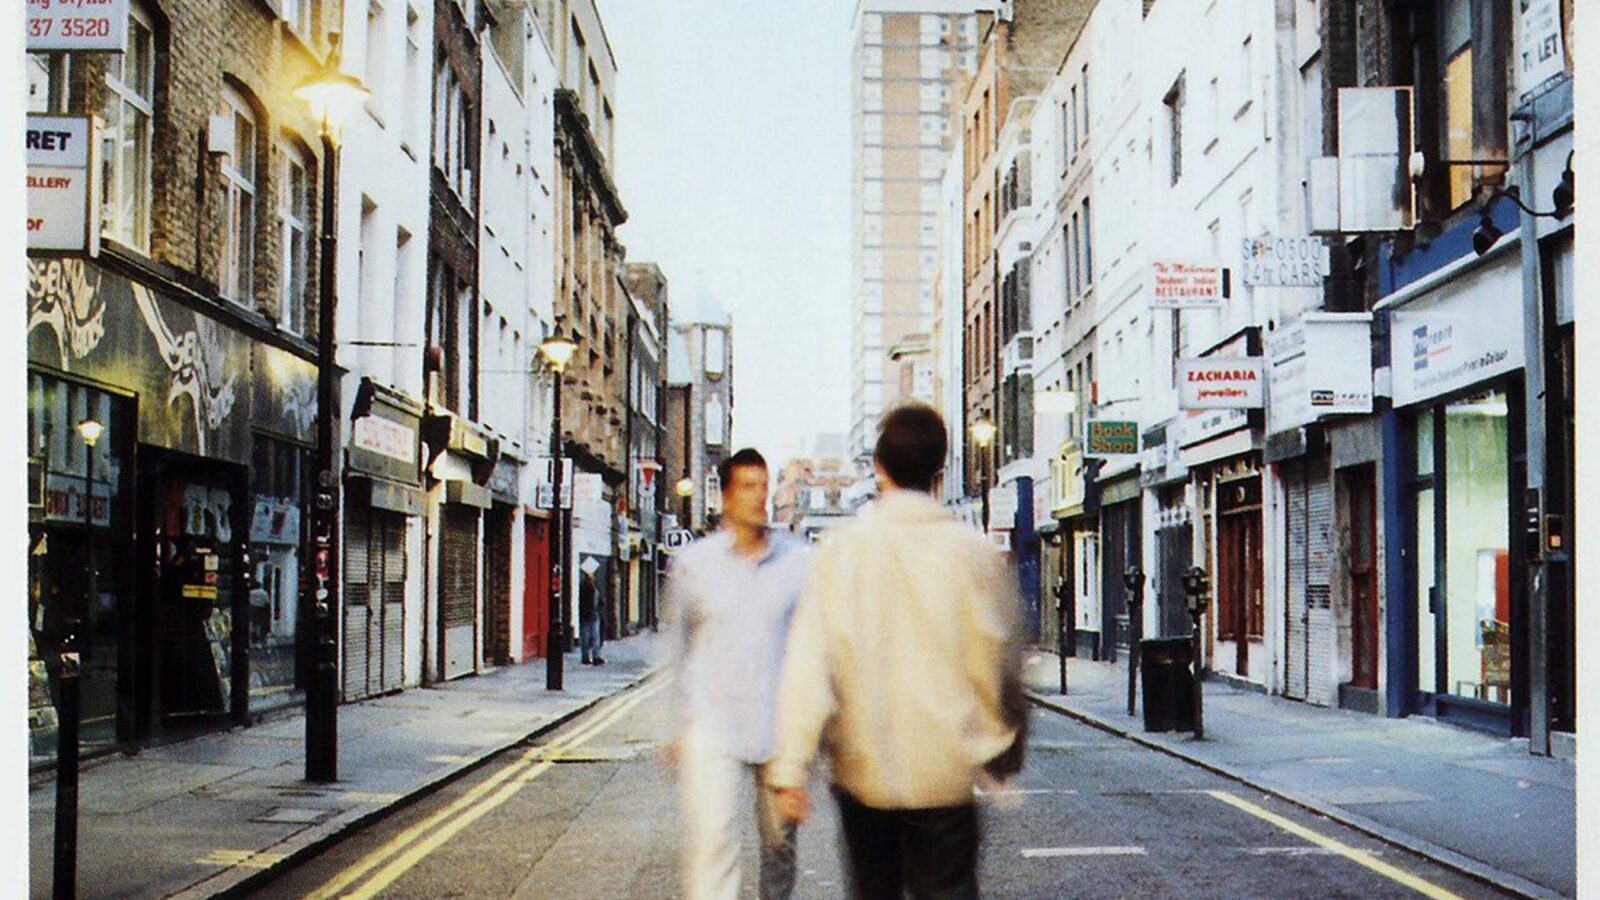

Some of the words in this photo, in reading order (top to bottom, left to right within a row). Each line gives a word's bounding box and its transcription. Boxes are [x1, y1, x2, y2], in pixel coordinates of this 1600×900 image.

[61, 18, 109, 36] 3520
[1538, 33, 1557, 62] LET
[26, 129, 71, 151] RET
[1279, 262, 1321, 285] CARS
[1154, 286, 1217, 298] RESTAURANT
[1187, 369, 1257, 382] ZACHARIA
[1197, 387, 1248, 401] jewellers
[1091, 422, 1135, 438] Book
[1091, 438, 1136, 453] Shop
